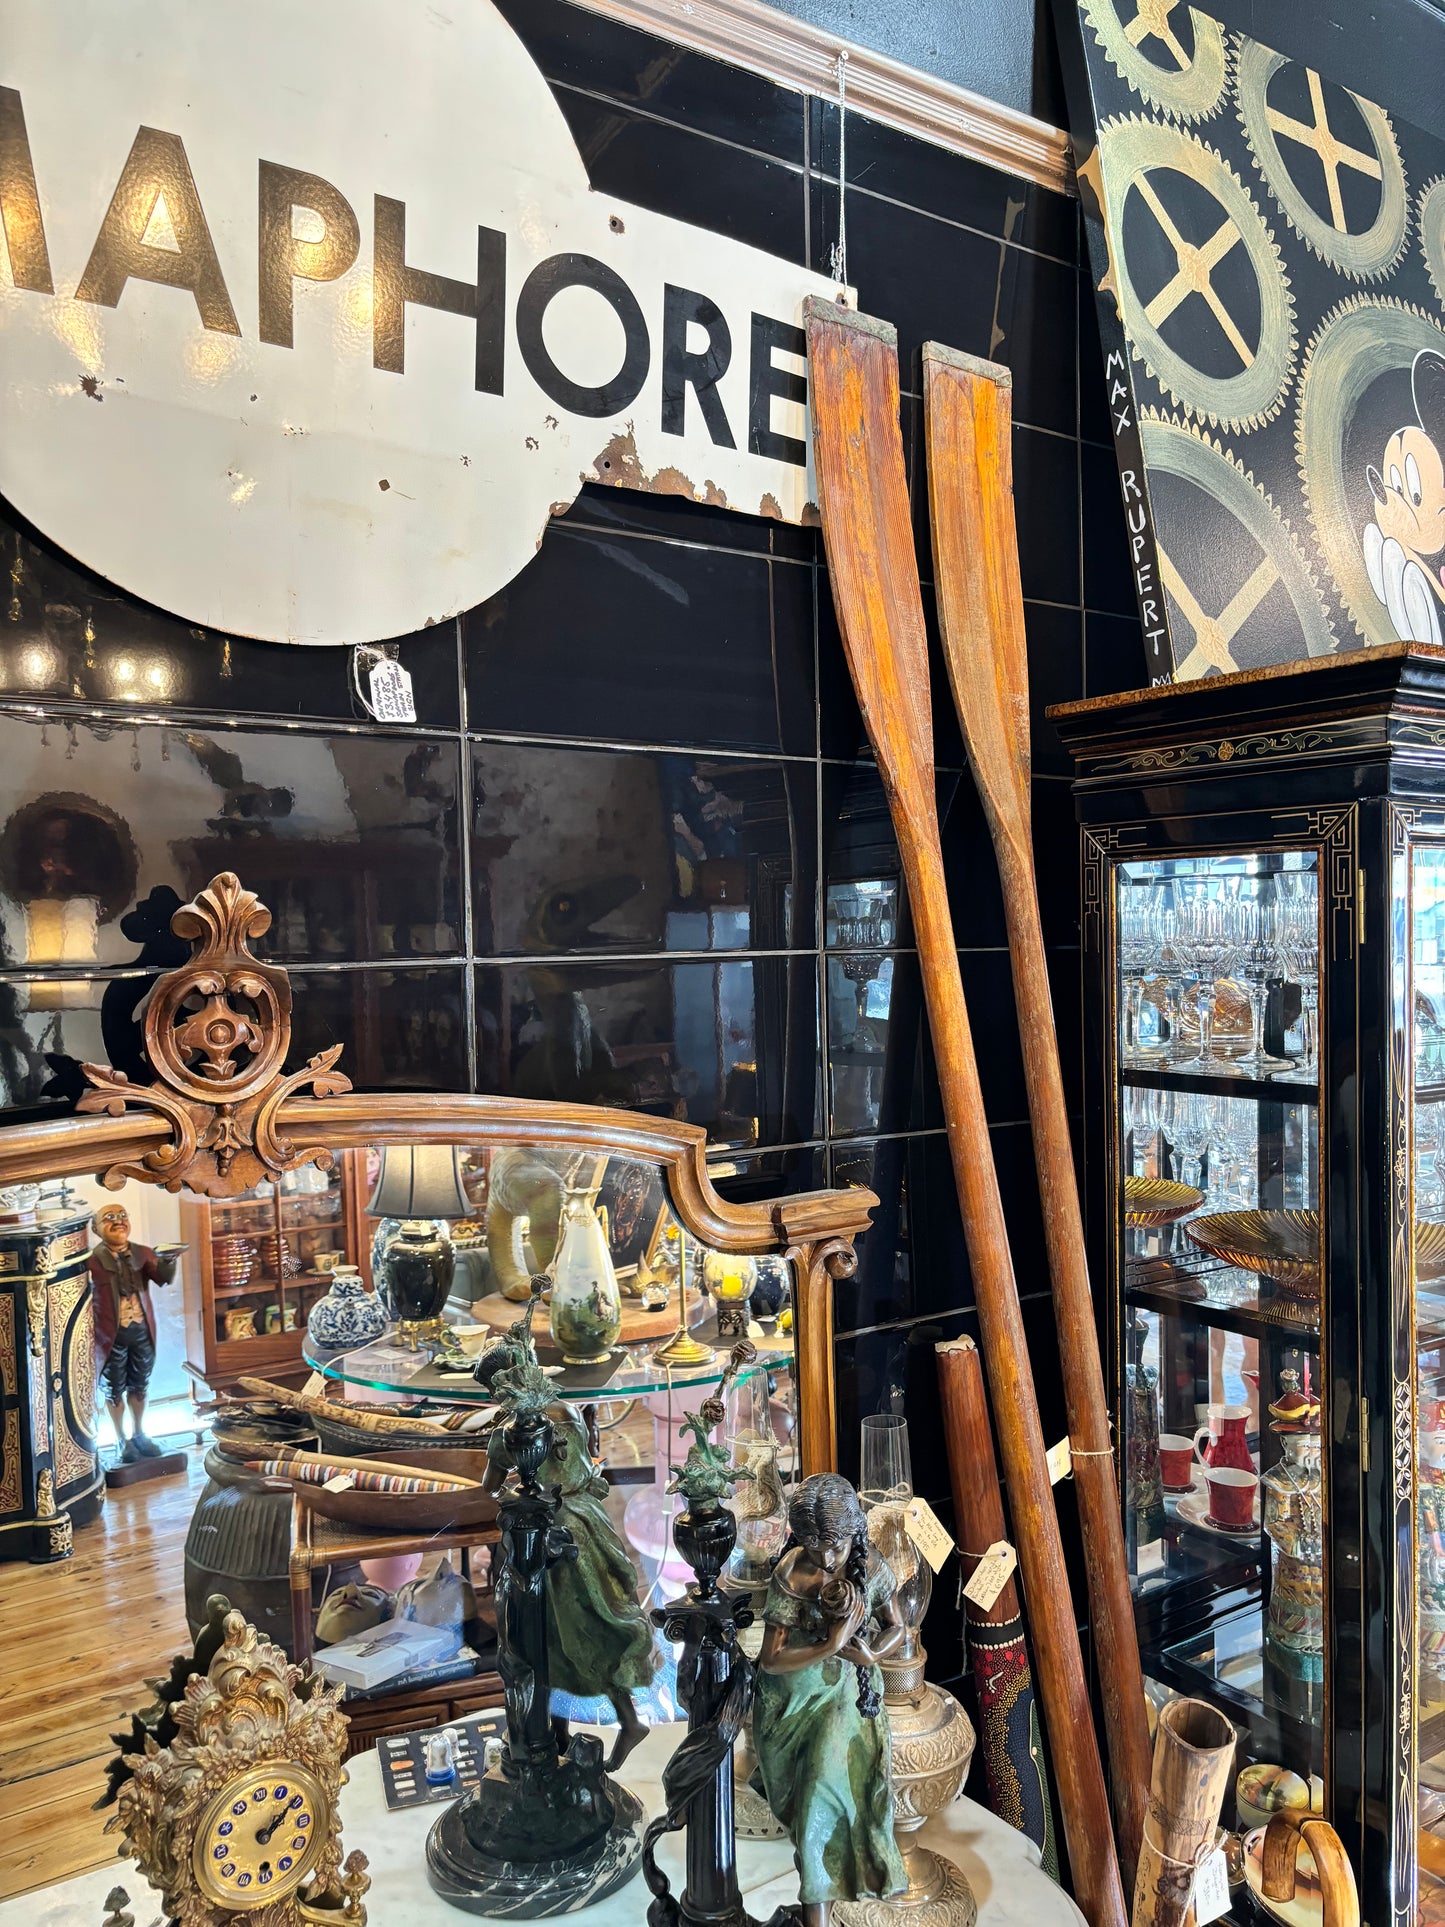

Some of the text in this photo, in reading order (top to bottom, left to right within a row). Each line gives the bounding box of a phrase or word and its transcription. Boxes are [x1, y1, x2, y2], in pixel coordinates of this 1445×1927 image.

[1106, 350, 1131, 436] MAX
[1122, 470, 1165, 655] RUPERT
[405, 691, 413, 711] SIGN
